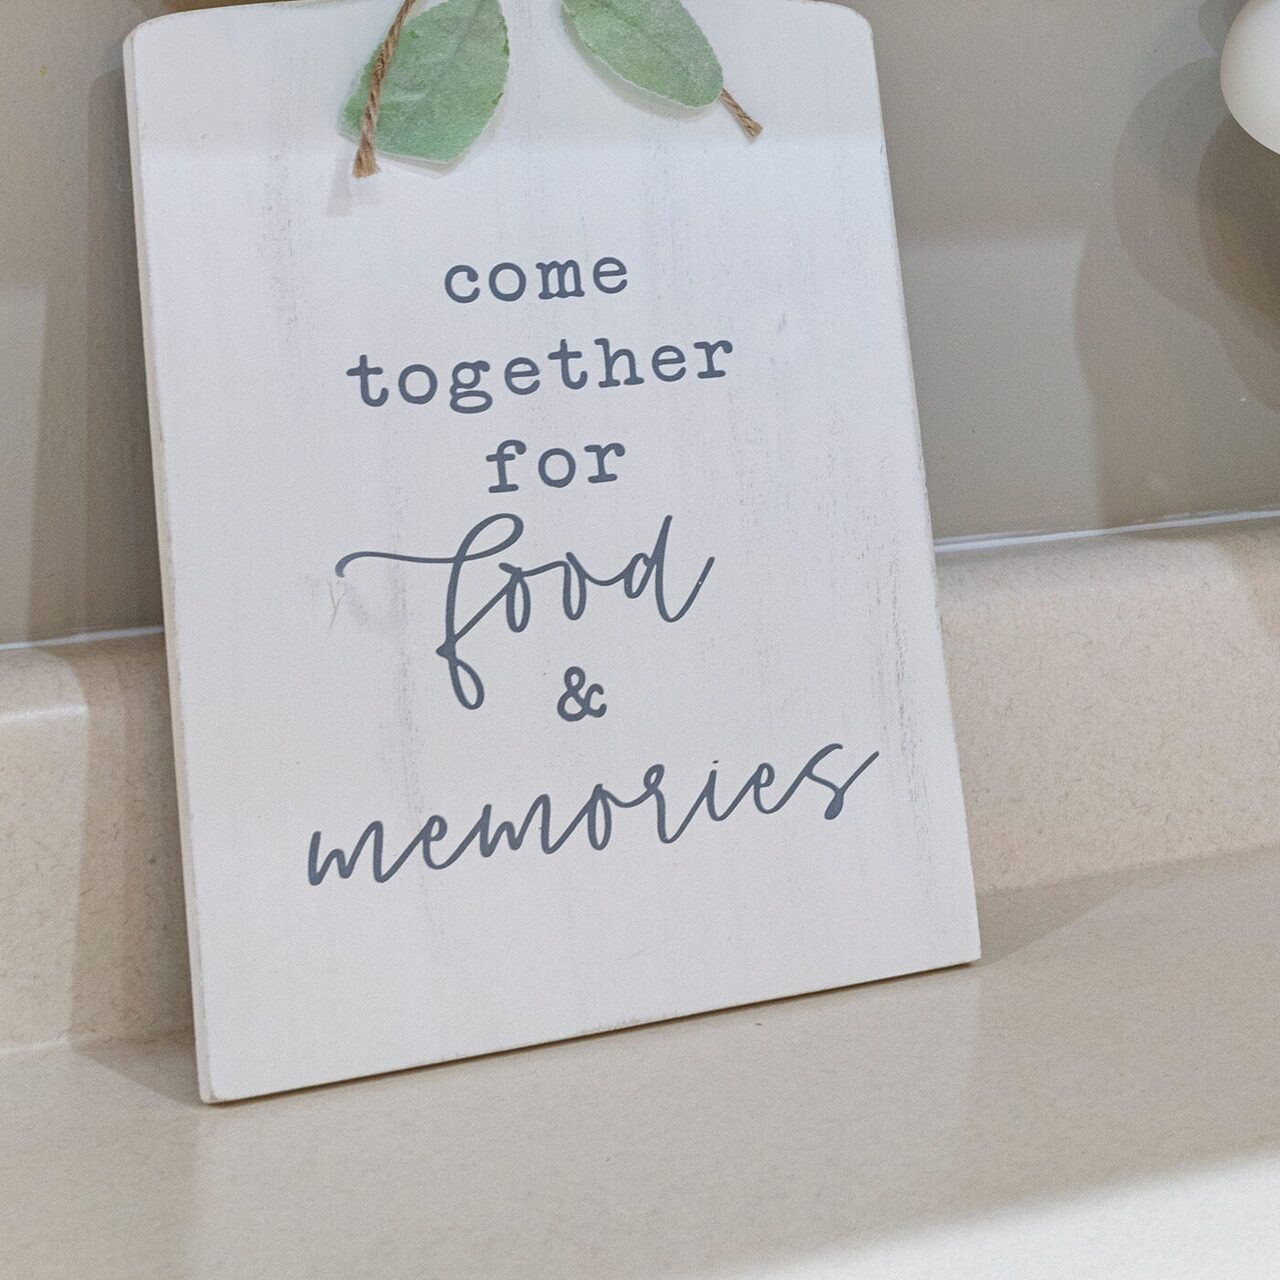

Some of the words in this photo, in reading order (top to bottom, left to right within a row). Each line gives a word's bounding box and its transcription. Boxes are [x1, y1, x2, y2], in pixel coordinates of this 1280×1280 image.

[444, 256, 629, 305] come
[345, 337, 735, 415] together
[485, 439, 627, 495] for
[334, 512, 716, 712] food
[556, 665, 608, 724] &
[307, 743, 880, 888] memories
